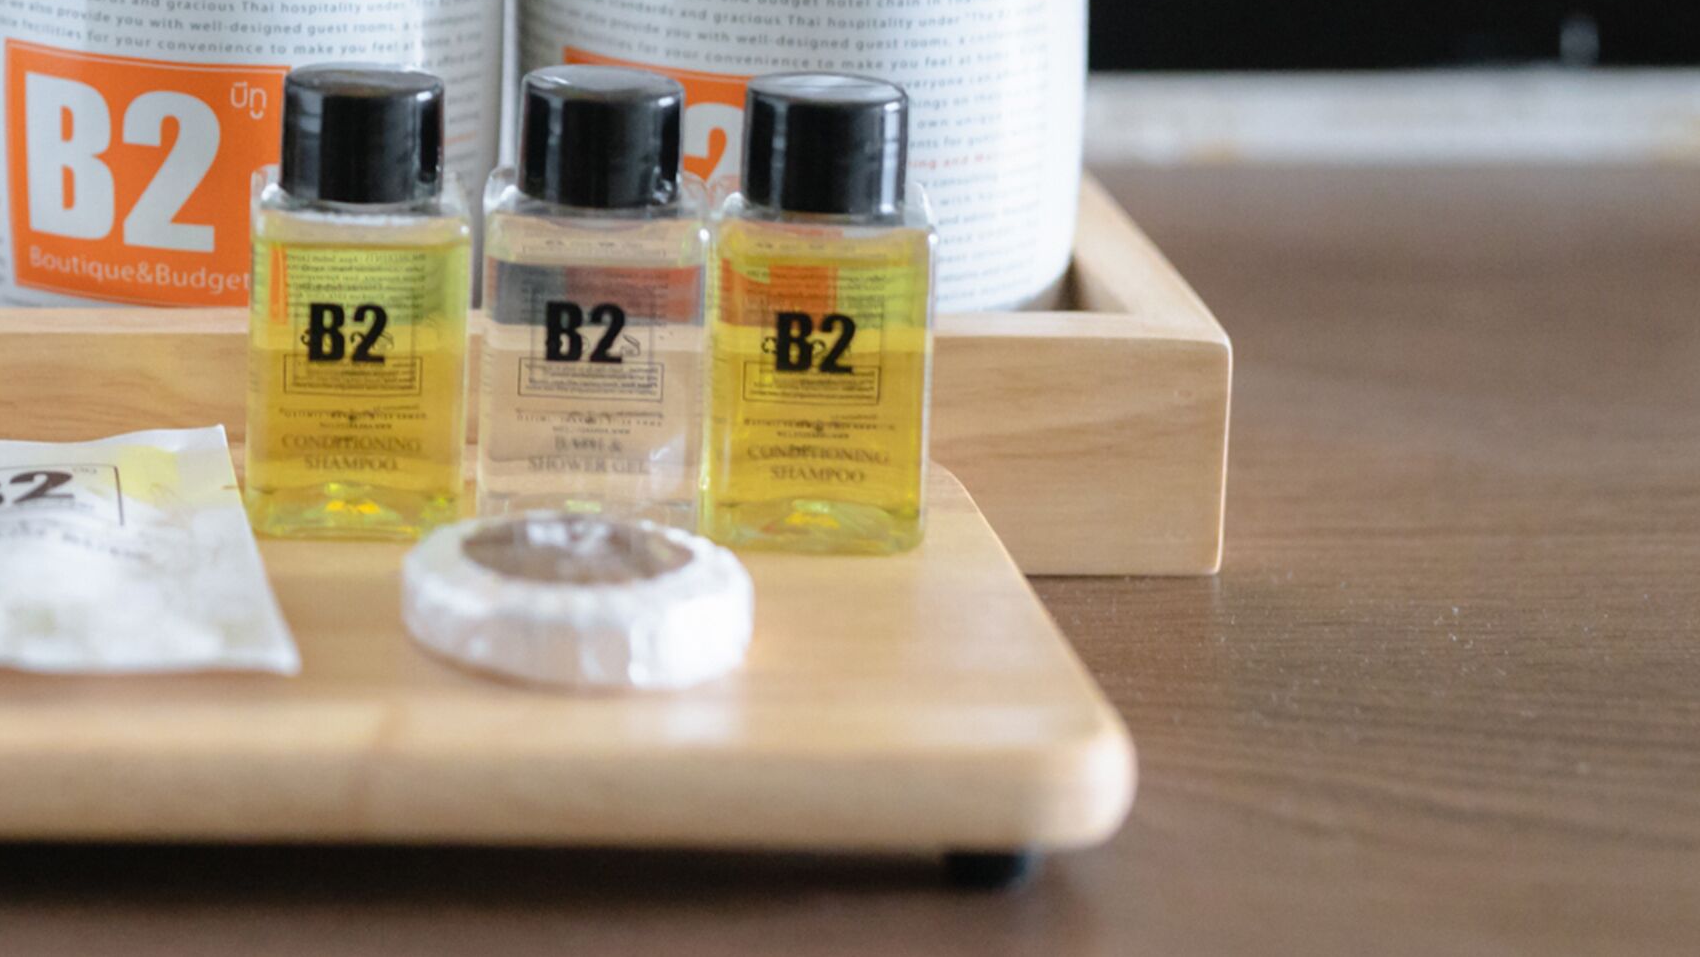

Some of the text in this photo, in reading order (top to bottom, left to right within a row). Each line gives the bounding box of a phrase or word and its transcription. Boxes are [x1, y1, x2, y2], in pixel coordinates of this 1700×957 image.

[57, 7, 111, 24] provide
[116, 15, 144, 28] you
[149, 18, 184, 31] with
[189, 20, 303, 37] well-designed
[307, 23, 349, 38] guest
[166, 0, 235, 12] gracious
[241, 0, 274, 13] Thai
[280, 1, 362, 16] hospitality
[679, 9, 708, 21] and
[713, 12, 781, 26] gracious
[787, 14, 821, 27] Thai
[827, 16, 913, 30] hospitality
[918, 15, 960, 27] under
[87, 29, 109, 43] for
[116, 34, 152, 48] your
[157, 37, 264, 55] convenience
[270, 43, 287, 55] to
[293, 43, 334, 55] make
[339, 43, 367, 57] you
[609, 16, 660, 33] provide
[665, 27, 692, 40] you
[696, 29, 730, 43] with
[735, 34, 850, 50] well-designed
[855, 38, 899, 52] guest
[665, 47, 698, 59] your
[704, 52, 810, 69] convenience
[817, 58, 835, 70] to
[841, 58, 884, 71] make
[890, 59, 919, 72] you
[924, 54, 953, 68] feel
[24, 71, 221, 253] B2
[308, 303, 388, 363] B2
[546, 300, 626, 364] B2
[776, 312, 857, 374] B2
[281, 433, 423, 453] CONDITIONING
